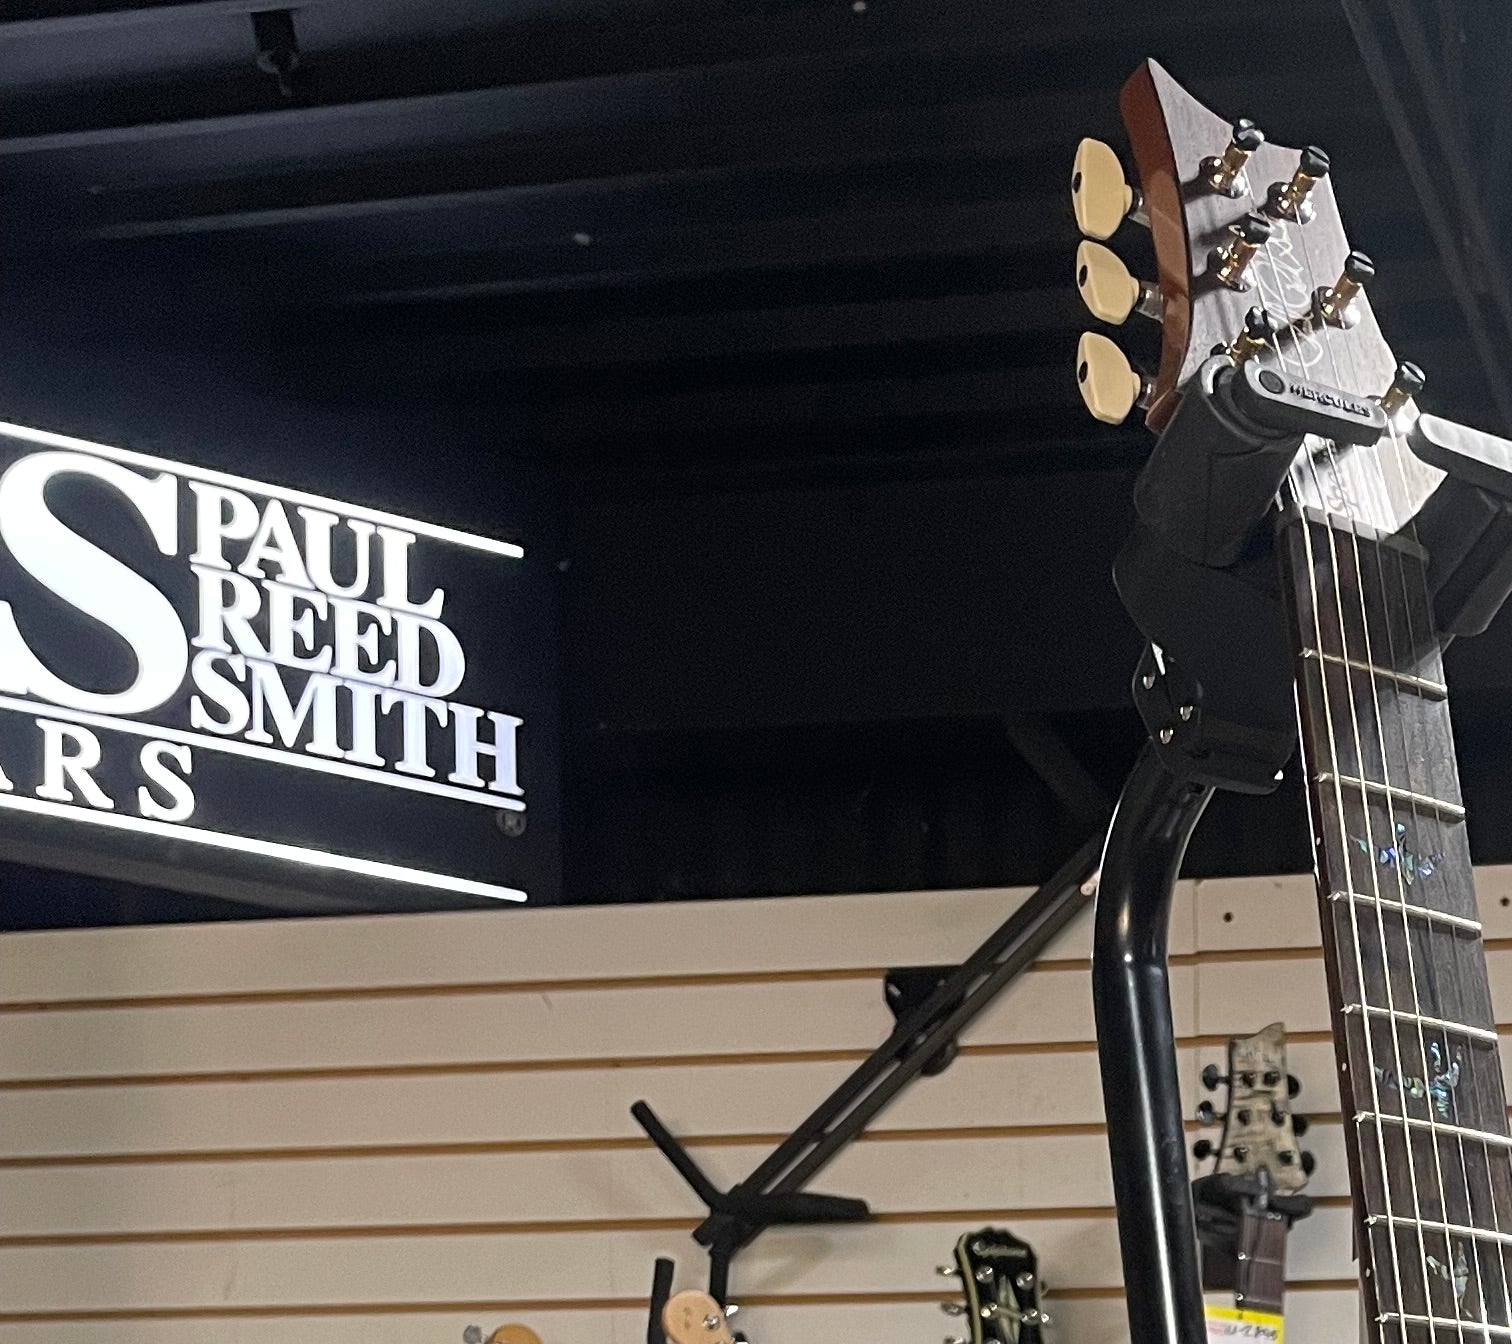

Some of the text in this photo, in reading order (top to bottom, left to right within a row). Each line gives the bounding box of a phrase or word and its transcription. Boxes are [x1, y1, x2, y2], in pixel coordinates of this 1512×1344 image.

[0, 450, 190, 715] S
[188, 480, 445, 619] PAUL
[190, 563, 466, 698] REED
[0, 717, 196, 822] RS
[190, 649, 525, 796] SMITH
